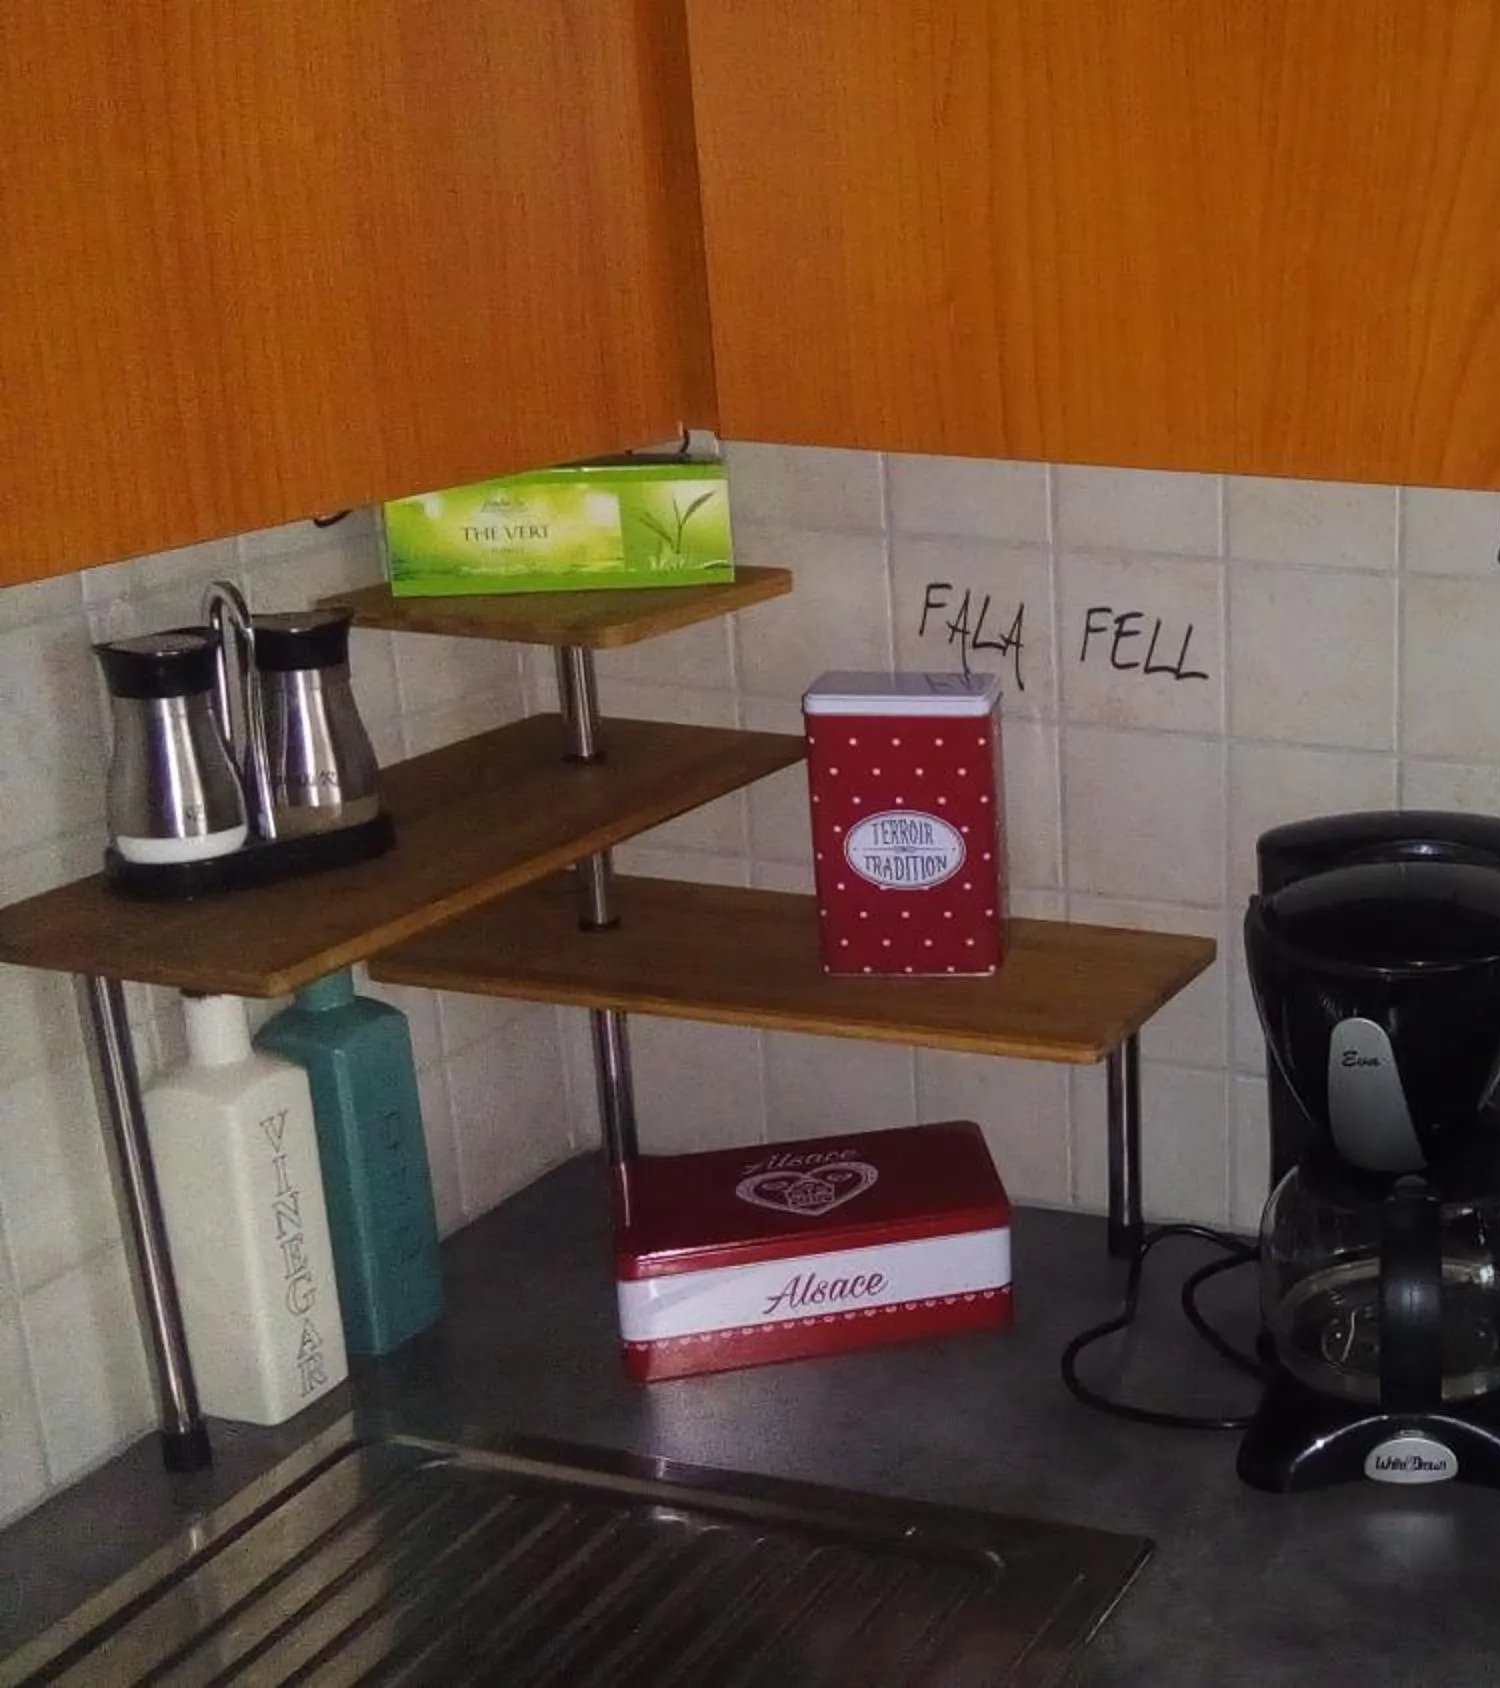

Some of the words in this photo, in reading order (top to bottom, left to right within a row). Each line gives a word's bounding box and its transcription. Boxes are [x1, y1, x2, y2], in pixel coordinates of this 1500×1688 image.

[918, 583, 1025, 692] FALA
[1079, 606, 1210, 680] FELL
[870, 818, 936, 847] TERROIR
[864, 854, 948, 881] TRADITION
[258, 1108, 329, 1398] VINEGAR
[762, 1270, 890, 1315] Alsace
